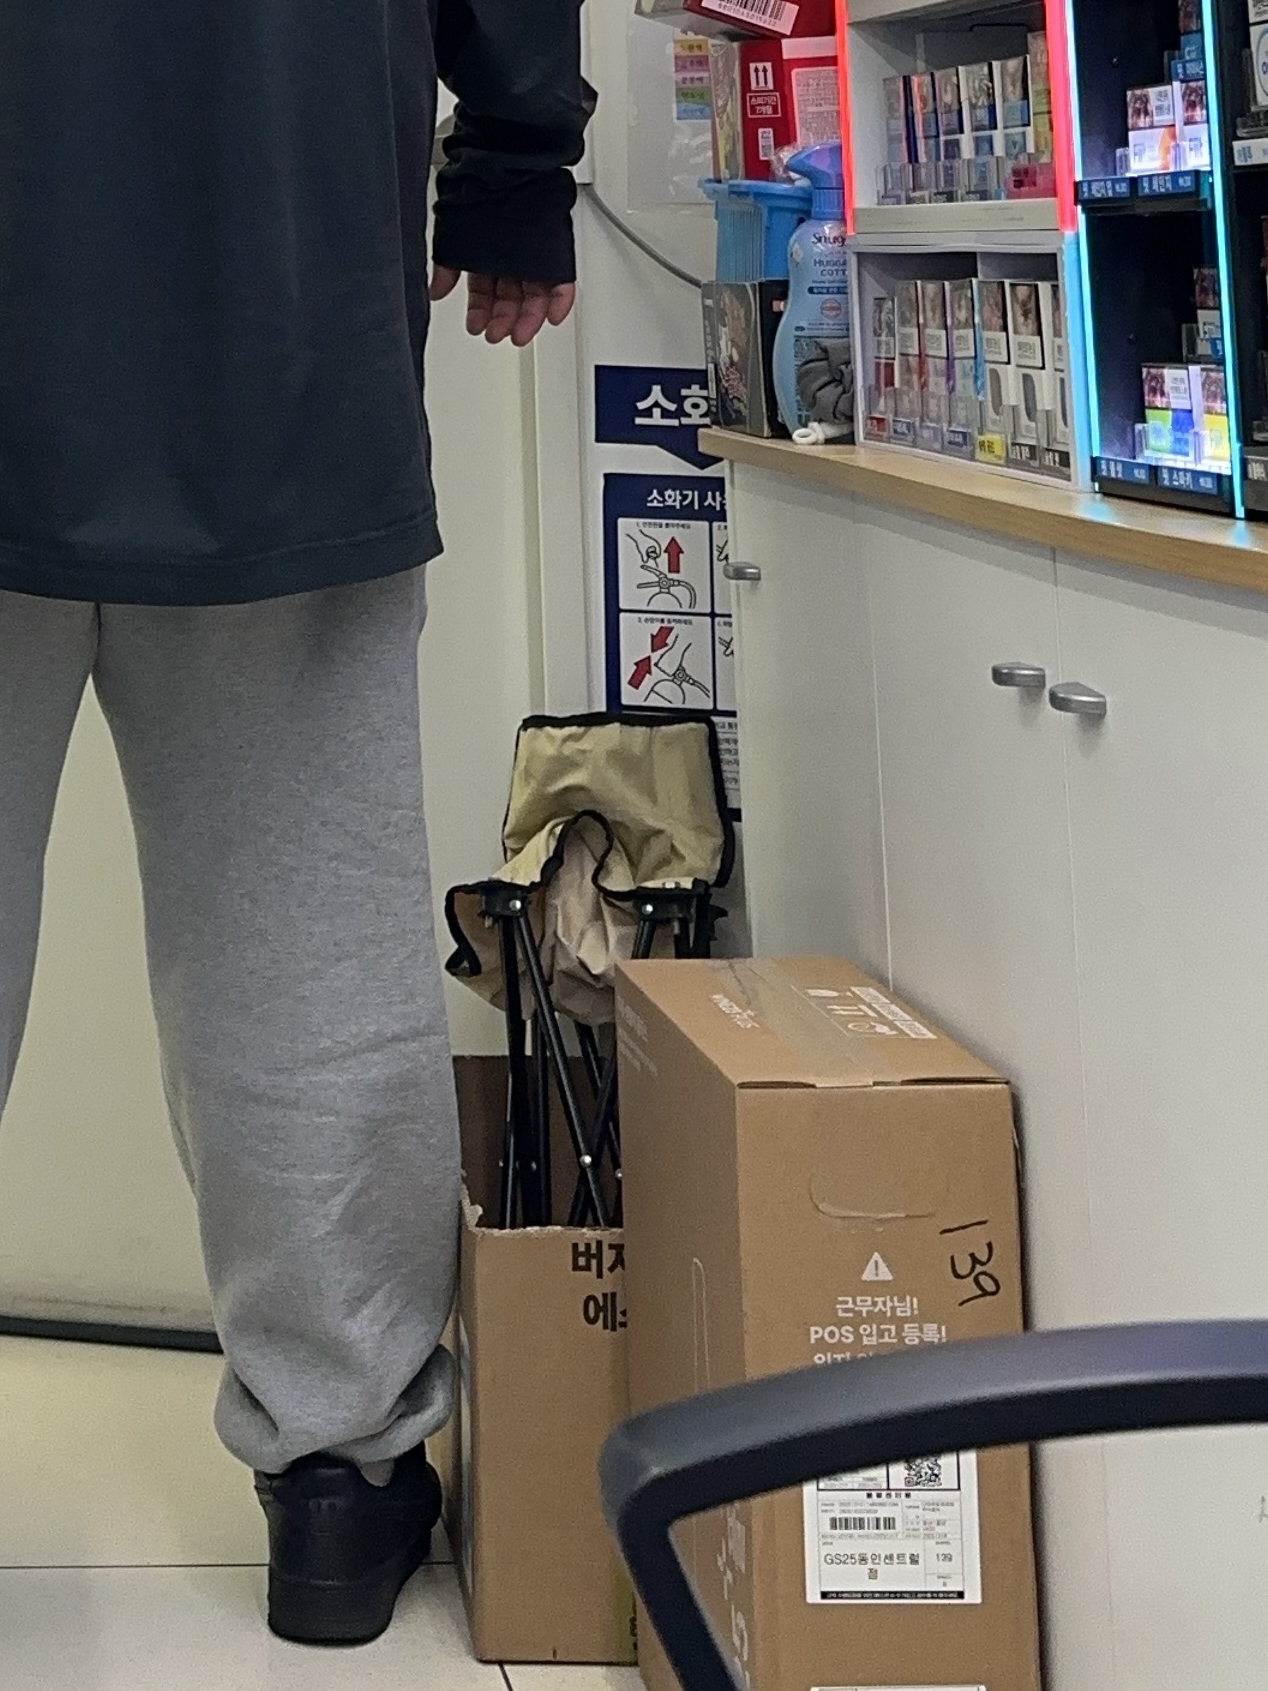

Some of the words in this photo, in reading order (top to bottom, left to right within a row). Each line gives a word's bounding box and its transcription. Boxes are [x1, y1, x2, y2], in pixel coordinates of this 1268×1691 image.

[646, 489, 699, 510] 소화기
[835, 1294, 919, 1318] 근무자님!
[809, 1325, 854, 1344] POS
[859, 1323, 898, 1345] 입고
[902, 1323, 947, 1344] 등록!
